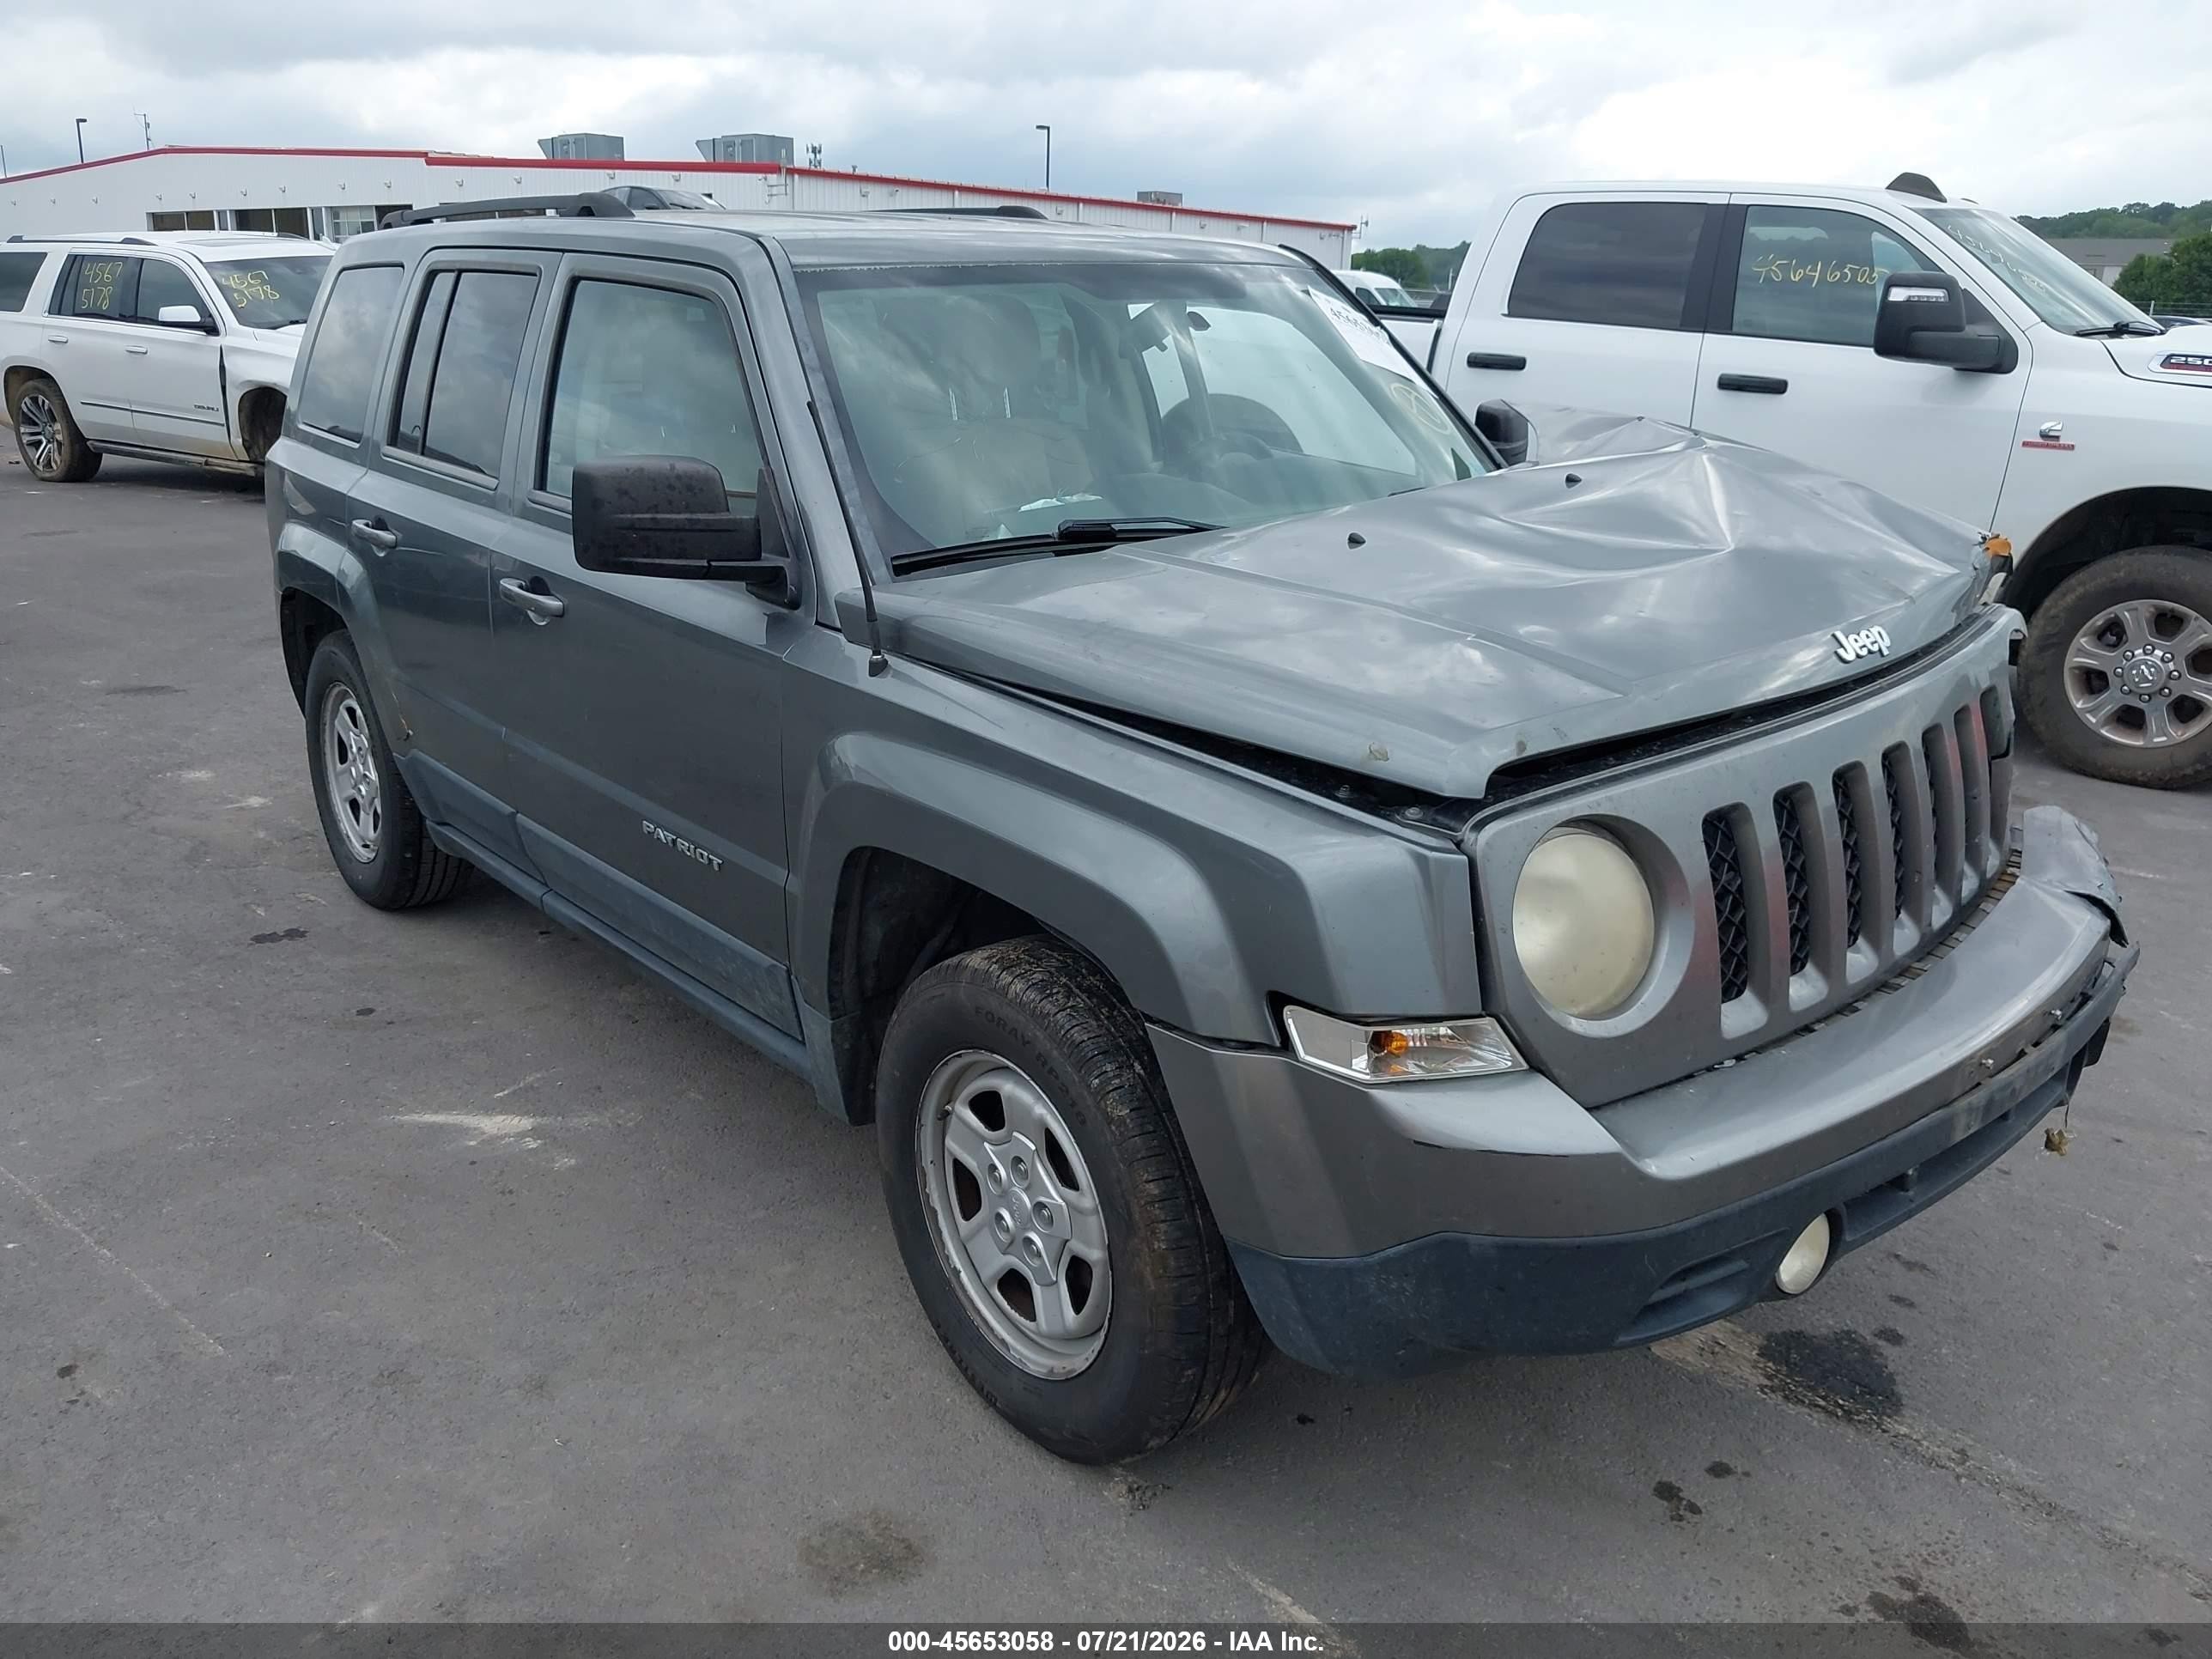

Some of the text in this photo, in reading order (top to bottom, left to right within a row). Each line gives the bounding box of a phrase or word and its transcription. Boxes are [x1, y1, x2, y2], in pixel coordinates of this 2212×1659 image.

[84, 261, 123, 283] 4567
[222, 270, 269, 289] 4567
[1752, 254, 1890, 288] 45646505
[82, 286, 112, 310] 5178
[234, 285, 280, 308] 5178
[1831, 625, 1891, 664] Jeep
[642, 819, 724, 872] PATRIOT
[975, 1006, 1030, 1047] FORAY
